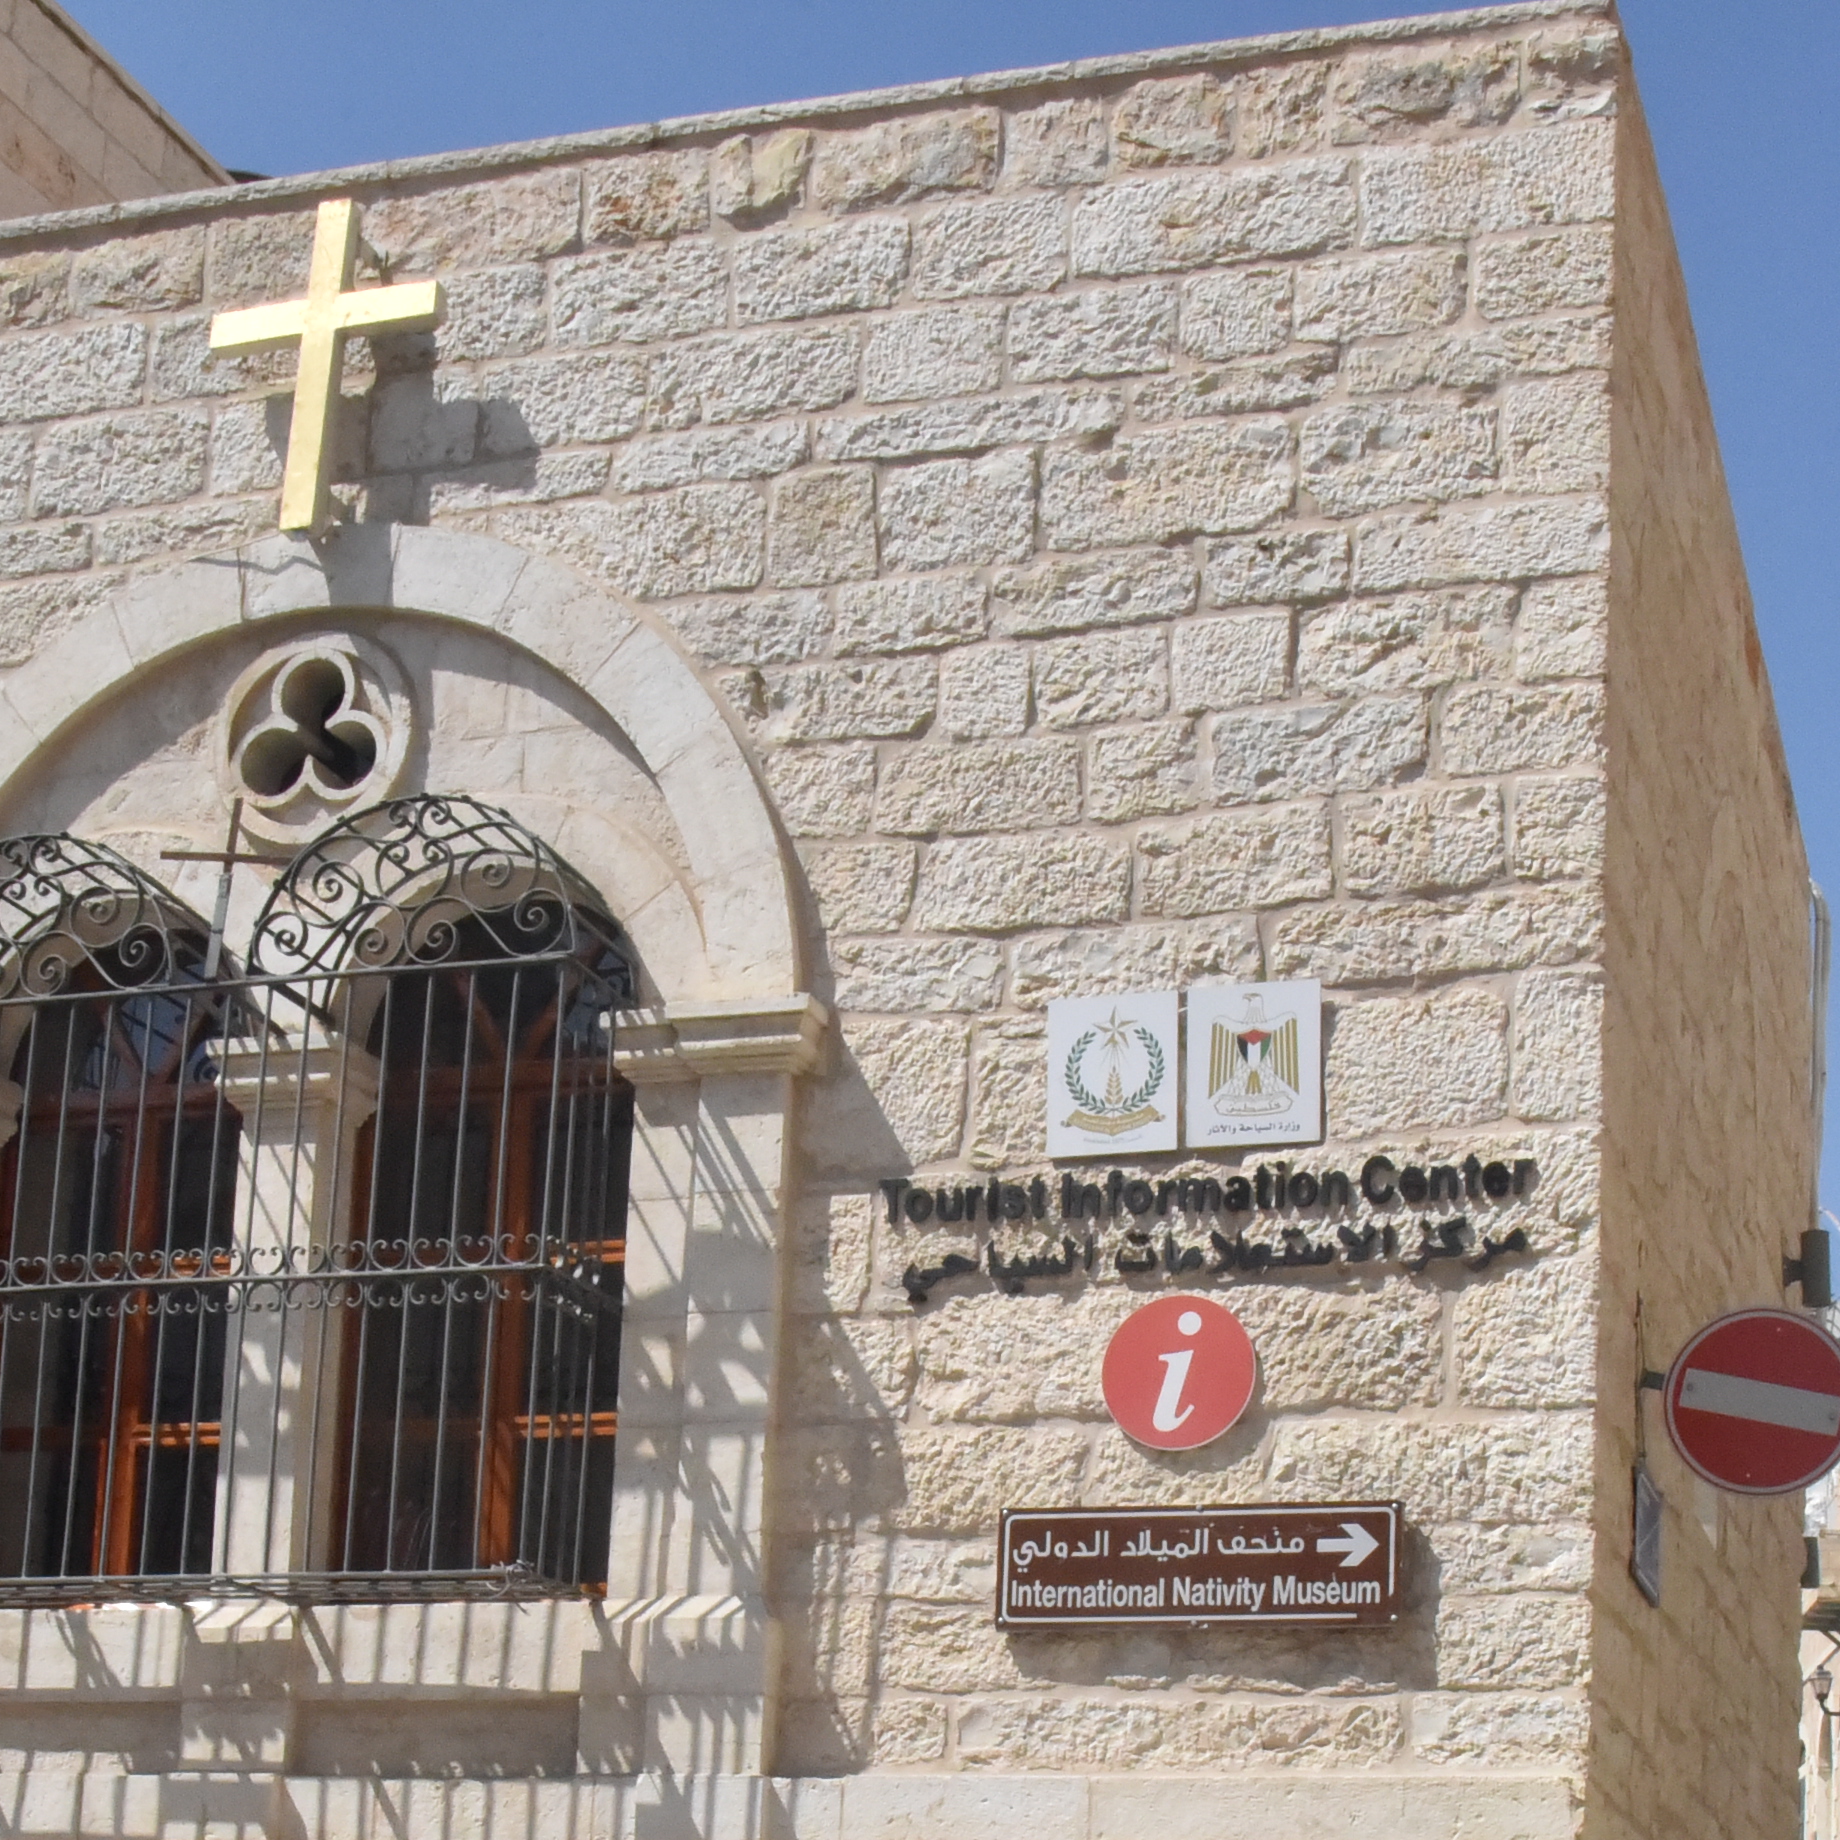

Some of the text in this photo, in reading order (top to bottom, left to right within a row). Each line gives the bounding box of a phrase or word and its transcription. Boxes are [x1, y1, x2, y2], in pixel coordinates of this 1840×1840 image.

[1239, 1122, 1276, 1133] السياحة
[878, 1154, 1535, 1225] Tourist Information Center
[1405, 1216, 1528, 1273] مركز
[1012, 1530, 1110, 1573] الدولي
[1120, 1527, 1209, 1562] الميلاد
[1011, 1575, 1381, 1612] International Nativity Museum
